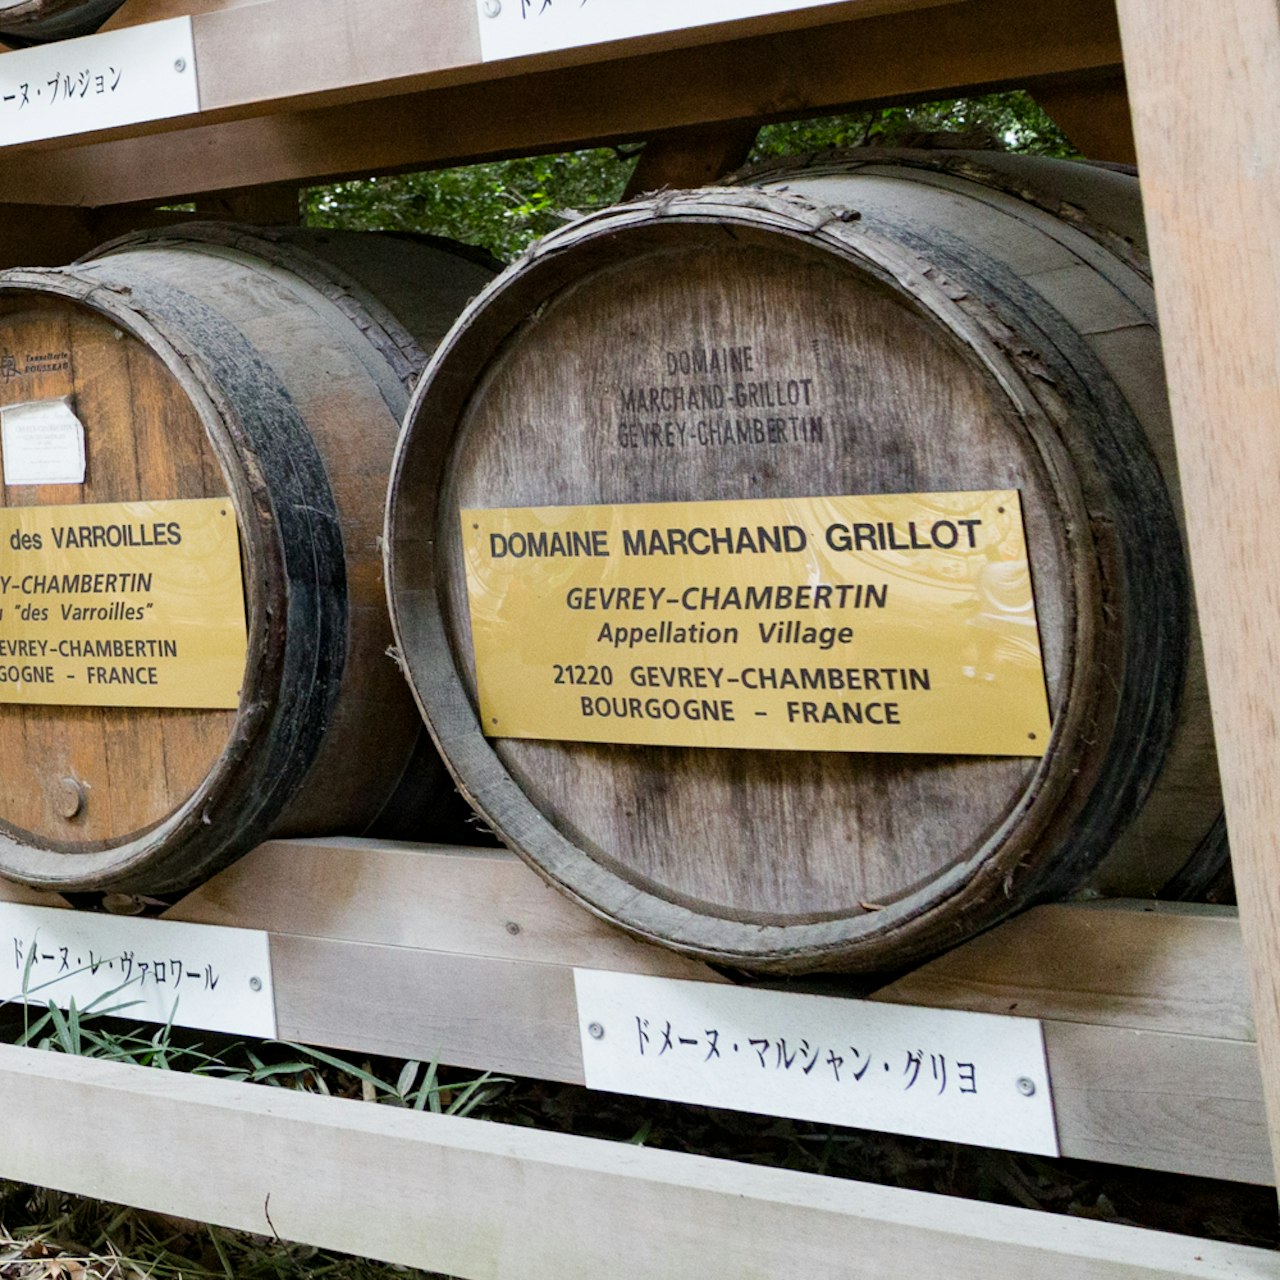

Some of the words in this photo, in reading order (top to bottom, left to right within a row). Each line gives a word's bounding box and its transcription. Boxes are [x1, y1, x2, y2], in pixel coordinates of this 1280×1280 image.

[666, 345, 754, 376] DOMAINE
[619, 378, 812, 413] MARCHAND-GRILLOT
[617, 416, 824, 449] GEVREY-CHAMBERTIN
[10, 528, 42, 550] des
[50, 522, 182, 549] VARROILLES
[489, 529, 610, 558] DOMAINE
[622, 524, 807, 557] MARCHAND
[825, 519, 982, 551] GRILLOT
[15, 604, 48, 621] "des
[61, 602, 153, 621] Varroilles"
[565, 584, 887, 611] GEVREY-CHAMBERTIN
[597, 621, 738, 649] Appellation
[758, 621, 854, 650] Village
[87, 667, 159, 685] FRANCE
[553, 664, 613, 686] 21220
[630, 666, 931, 691] GEVREY-CHAMBERTIN
[580, 696, 735, 721] BOURGOGNE
[787, 701, 901, 725] FRANCE
[635, 1015, 978, 1095] ドメーヌ・マルシャン・グリヨ
